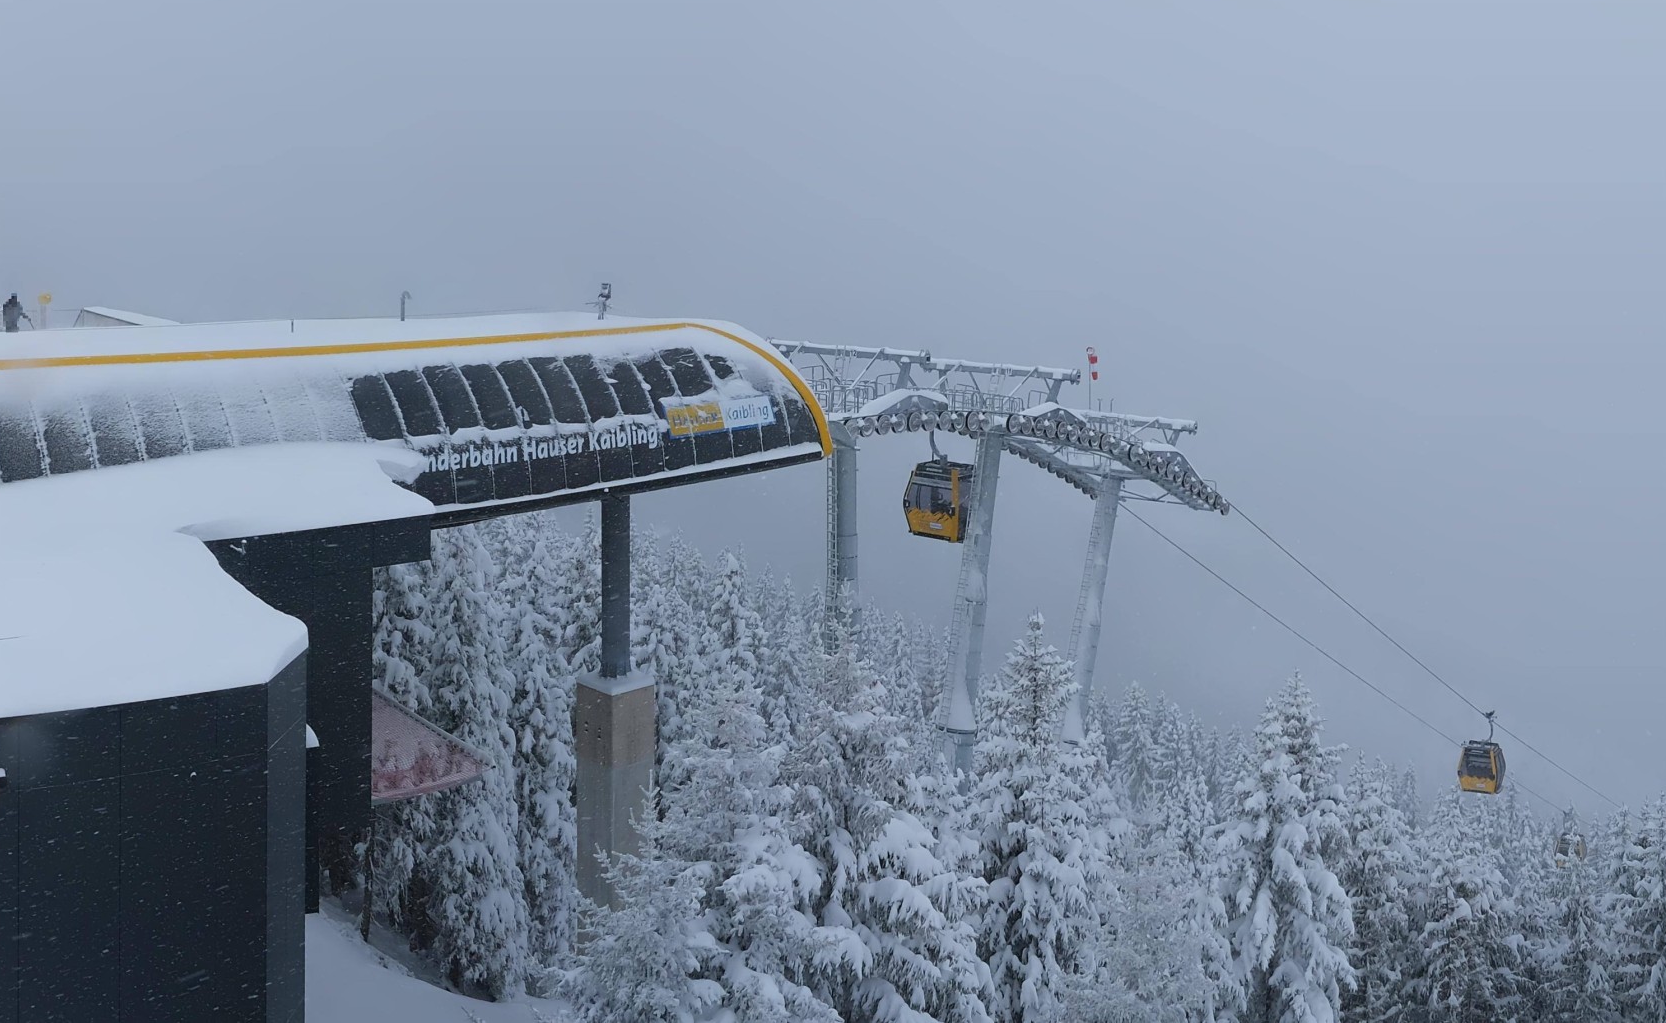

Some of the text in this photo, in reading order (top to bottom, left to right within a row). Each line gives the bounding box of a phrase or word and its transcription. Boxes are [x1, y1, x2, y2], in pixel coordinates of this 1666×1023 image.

[425, 426, 658, 473] nderbahn Hauser Kaibling
